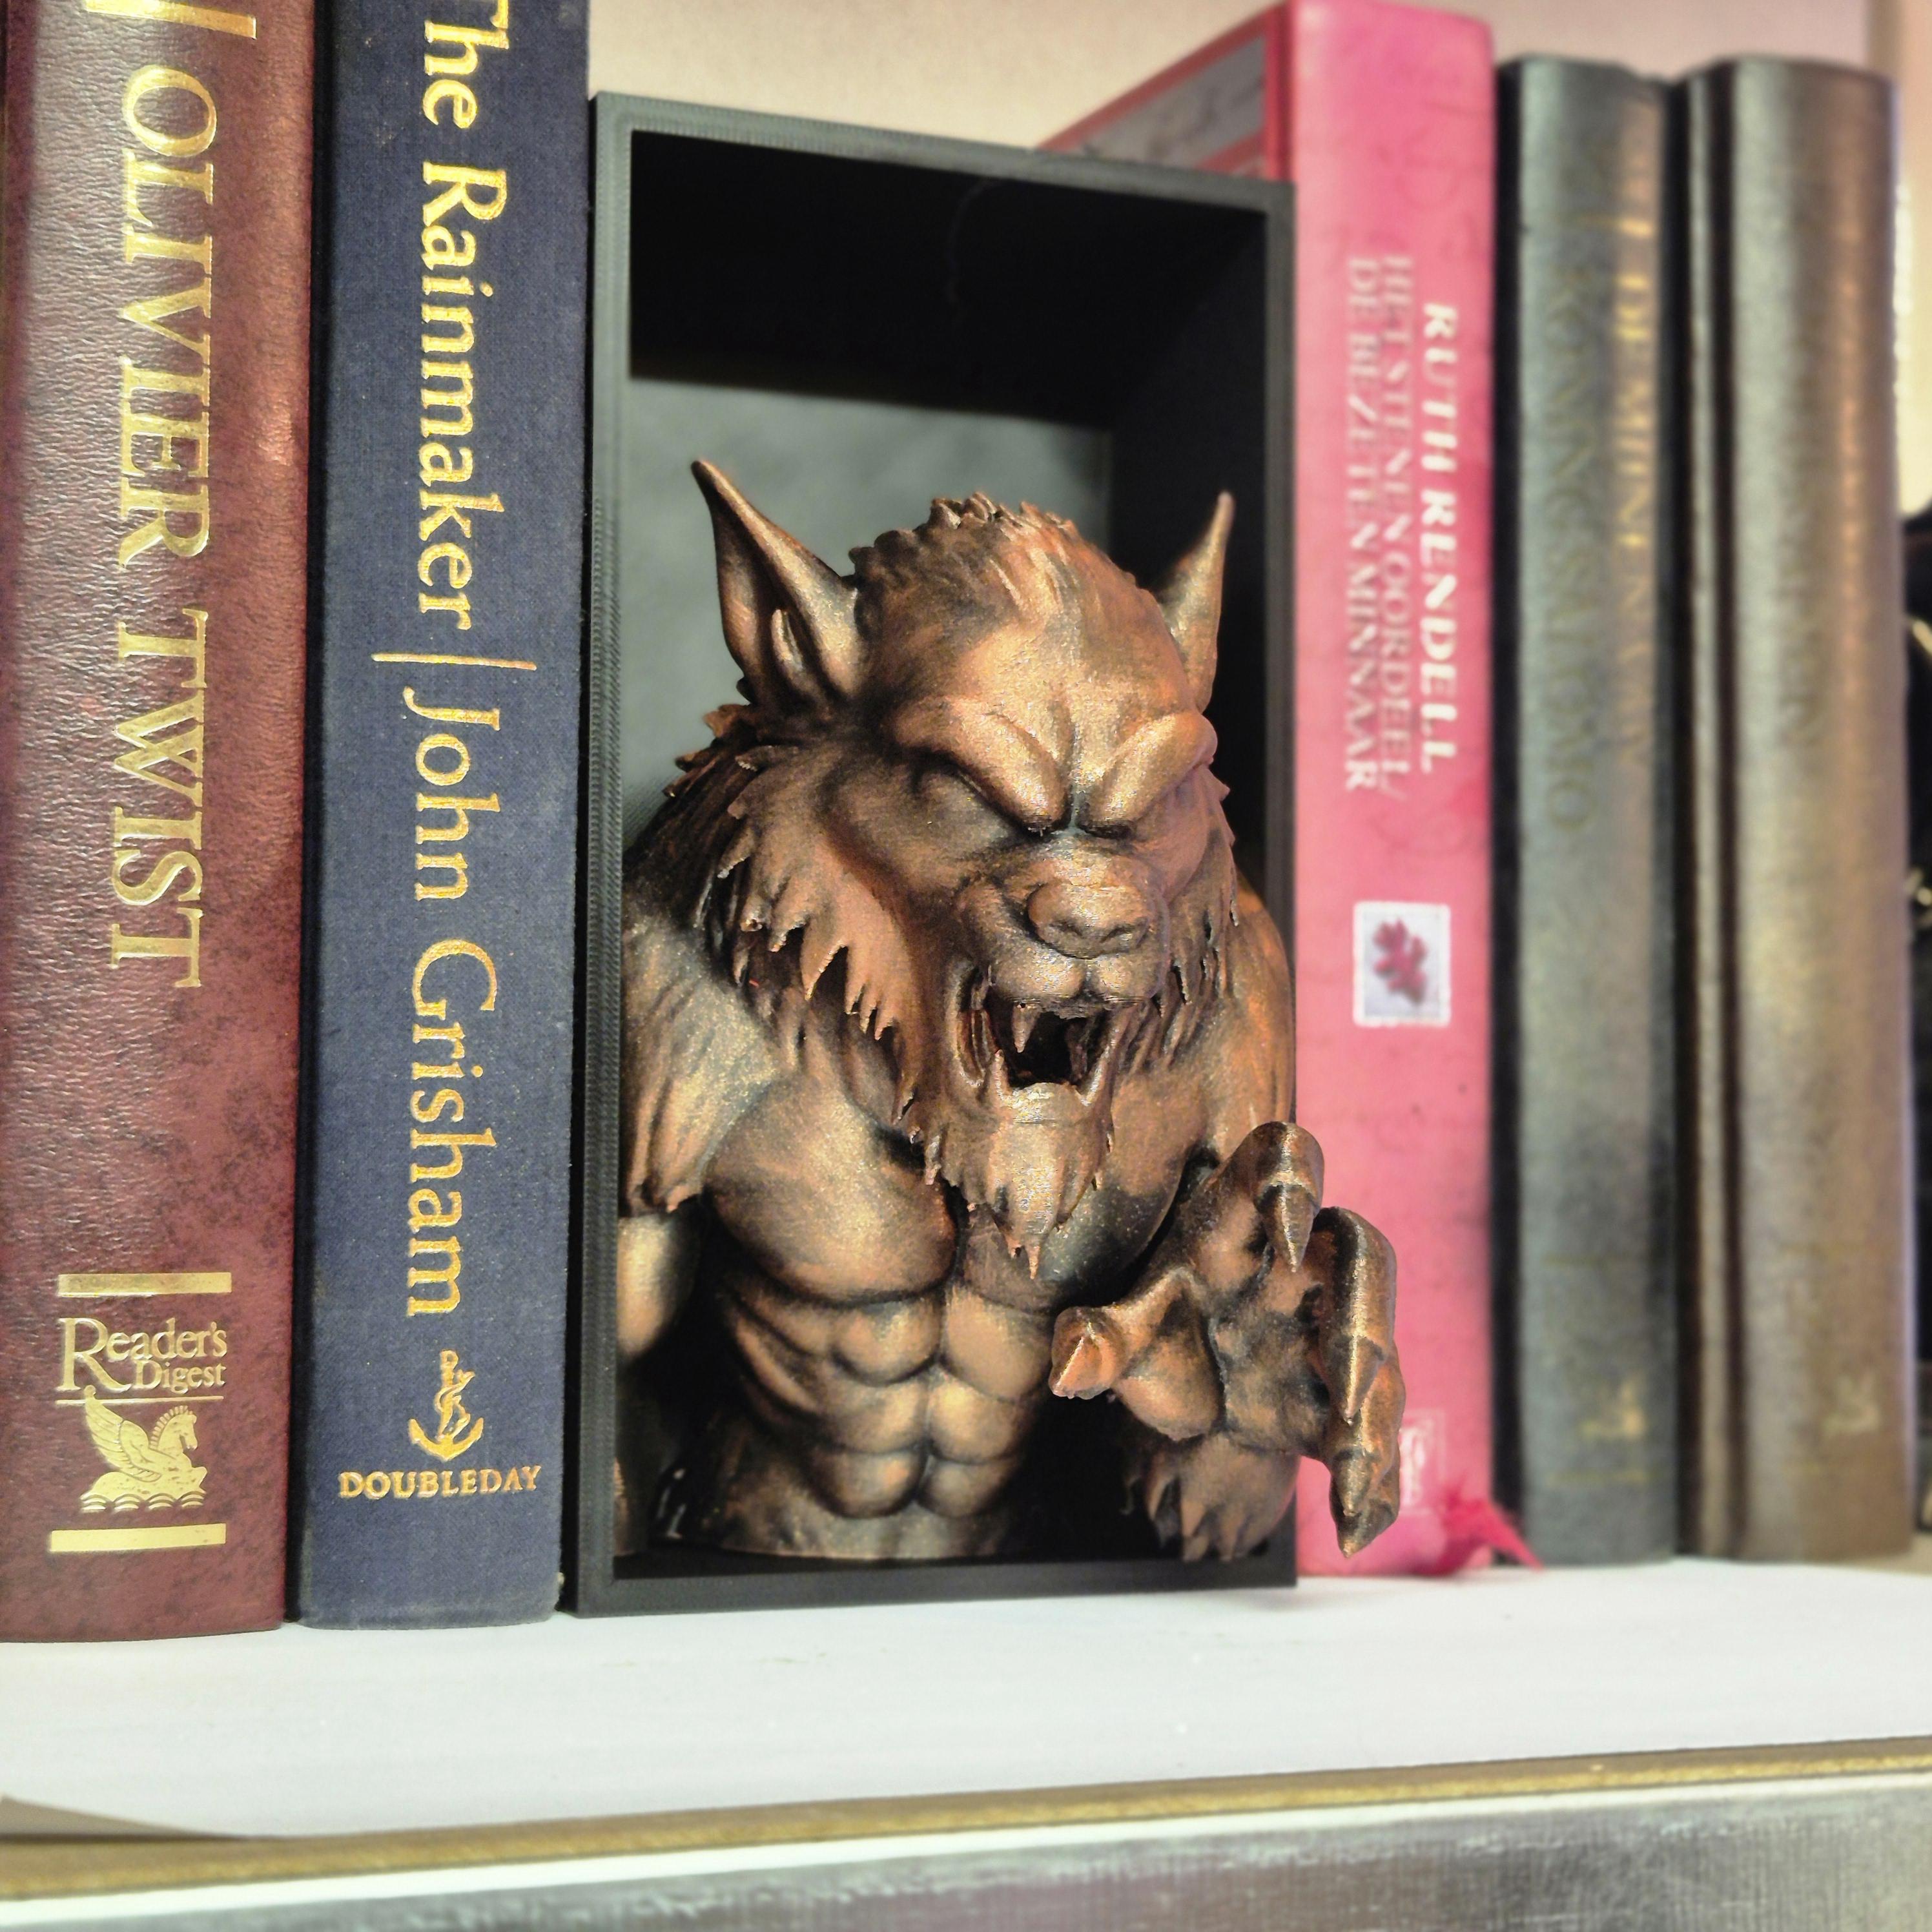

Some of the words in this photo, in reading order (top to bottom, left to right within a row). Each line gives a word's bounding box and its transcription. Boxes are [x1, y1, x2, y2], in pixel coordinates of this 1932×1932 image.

[118, 64, 218, 570] OLIVIER
[418, 159, 508, 630] Rainmaker
[1419, 302, 1459, 474] RUTH
[1419, 488, 1459, 776] RENDELL
[110, 608, 209, 988] TWIST
[404, 686, 500, 900] John
[407, 938, 497, 1317] Grisham
[57, 1317, 227, 1393] Reader's
[133, 1359, 226, 1394] Digest
[338, 1465, 541, 1500] DOUBLEDAY
